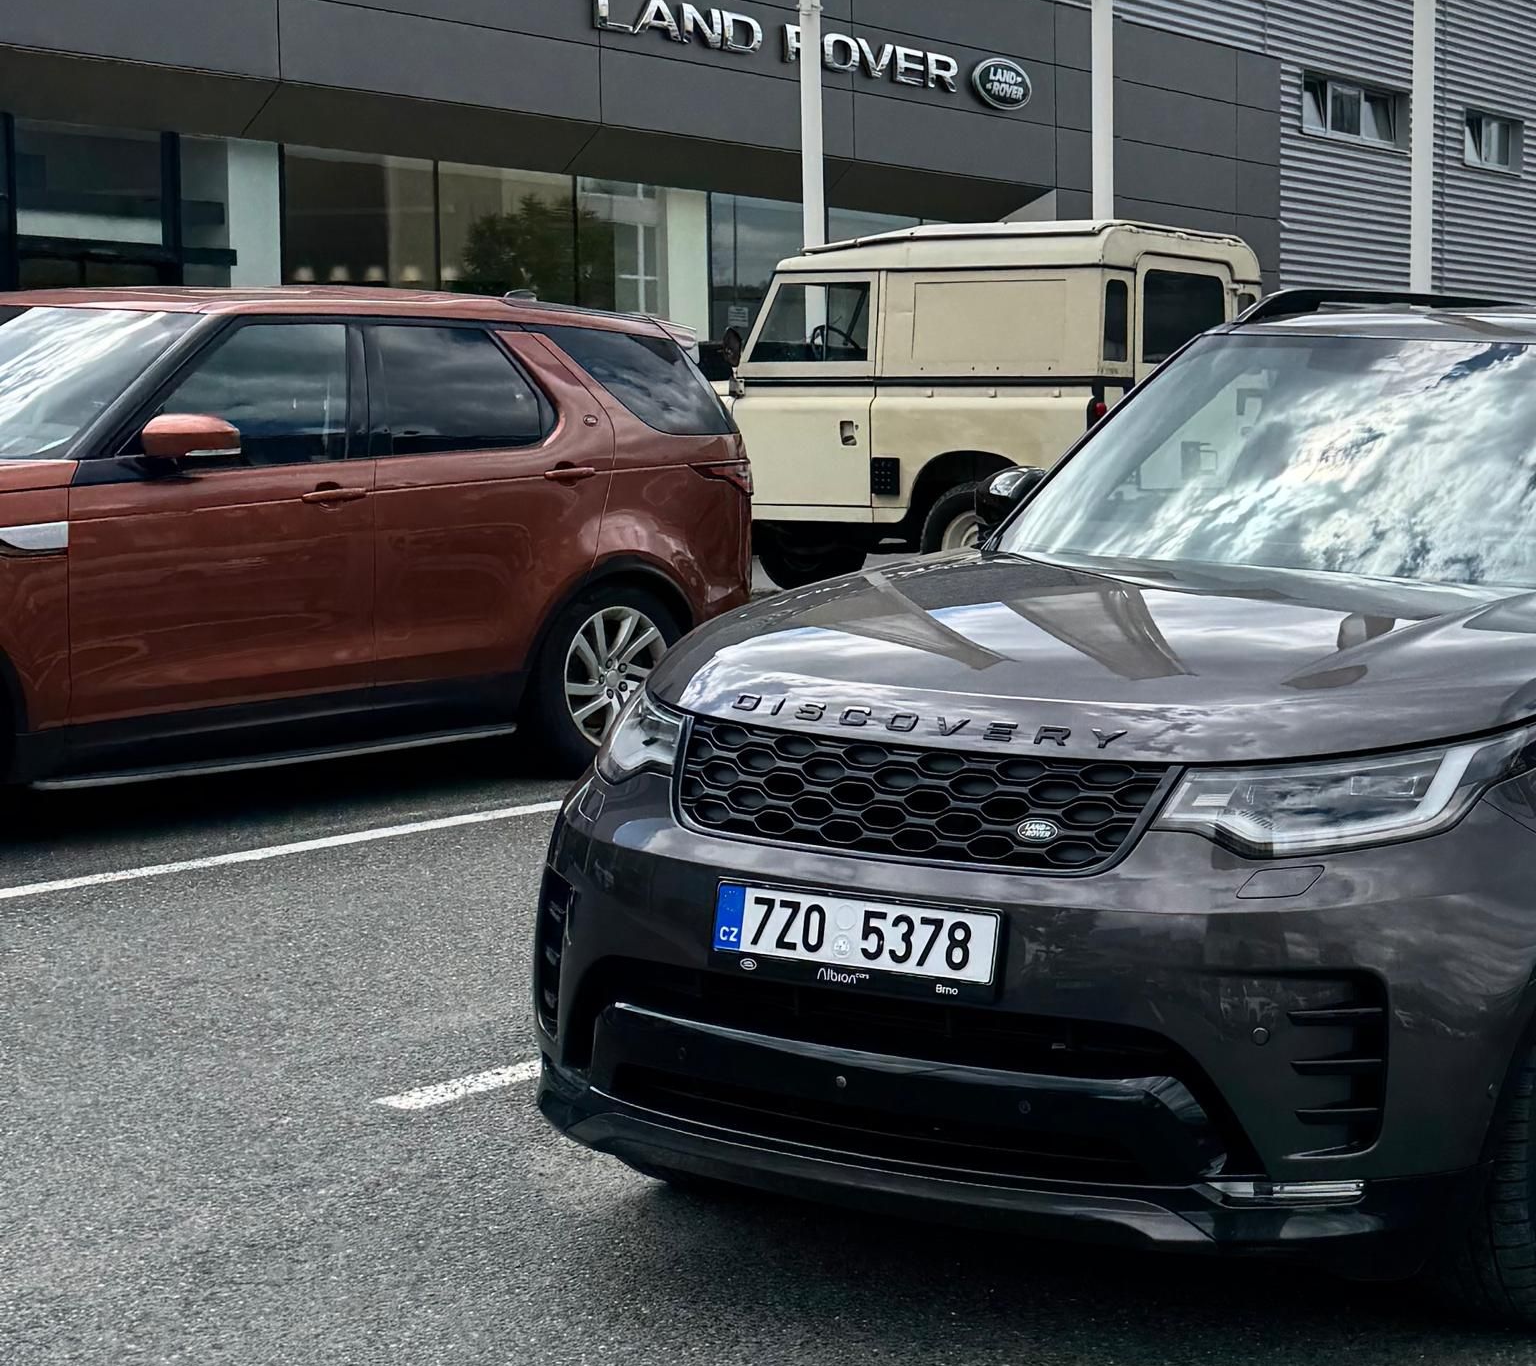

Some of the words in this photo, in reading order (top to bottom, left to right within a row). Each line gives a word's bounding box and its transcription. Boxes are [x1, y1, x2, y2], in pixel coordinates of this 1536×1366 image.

[989, 66, 1017, 85] LAND
[991, 81, 1024, 100] ROVER
[731, 693, 1129, 749] DISCOVERY
[720, 926, 738, 942] CZ
[750, 896, 826, 952] 7Z0
[860, 910, 972, 970] 5378
[817, 967, 856, 984] Albion
[936, 984, 958, 995] Brno
